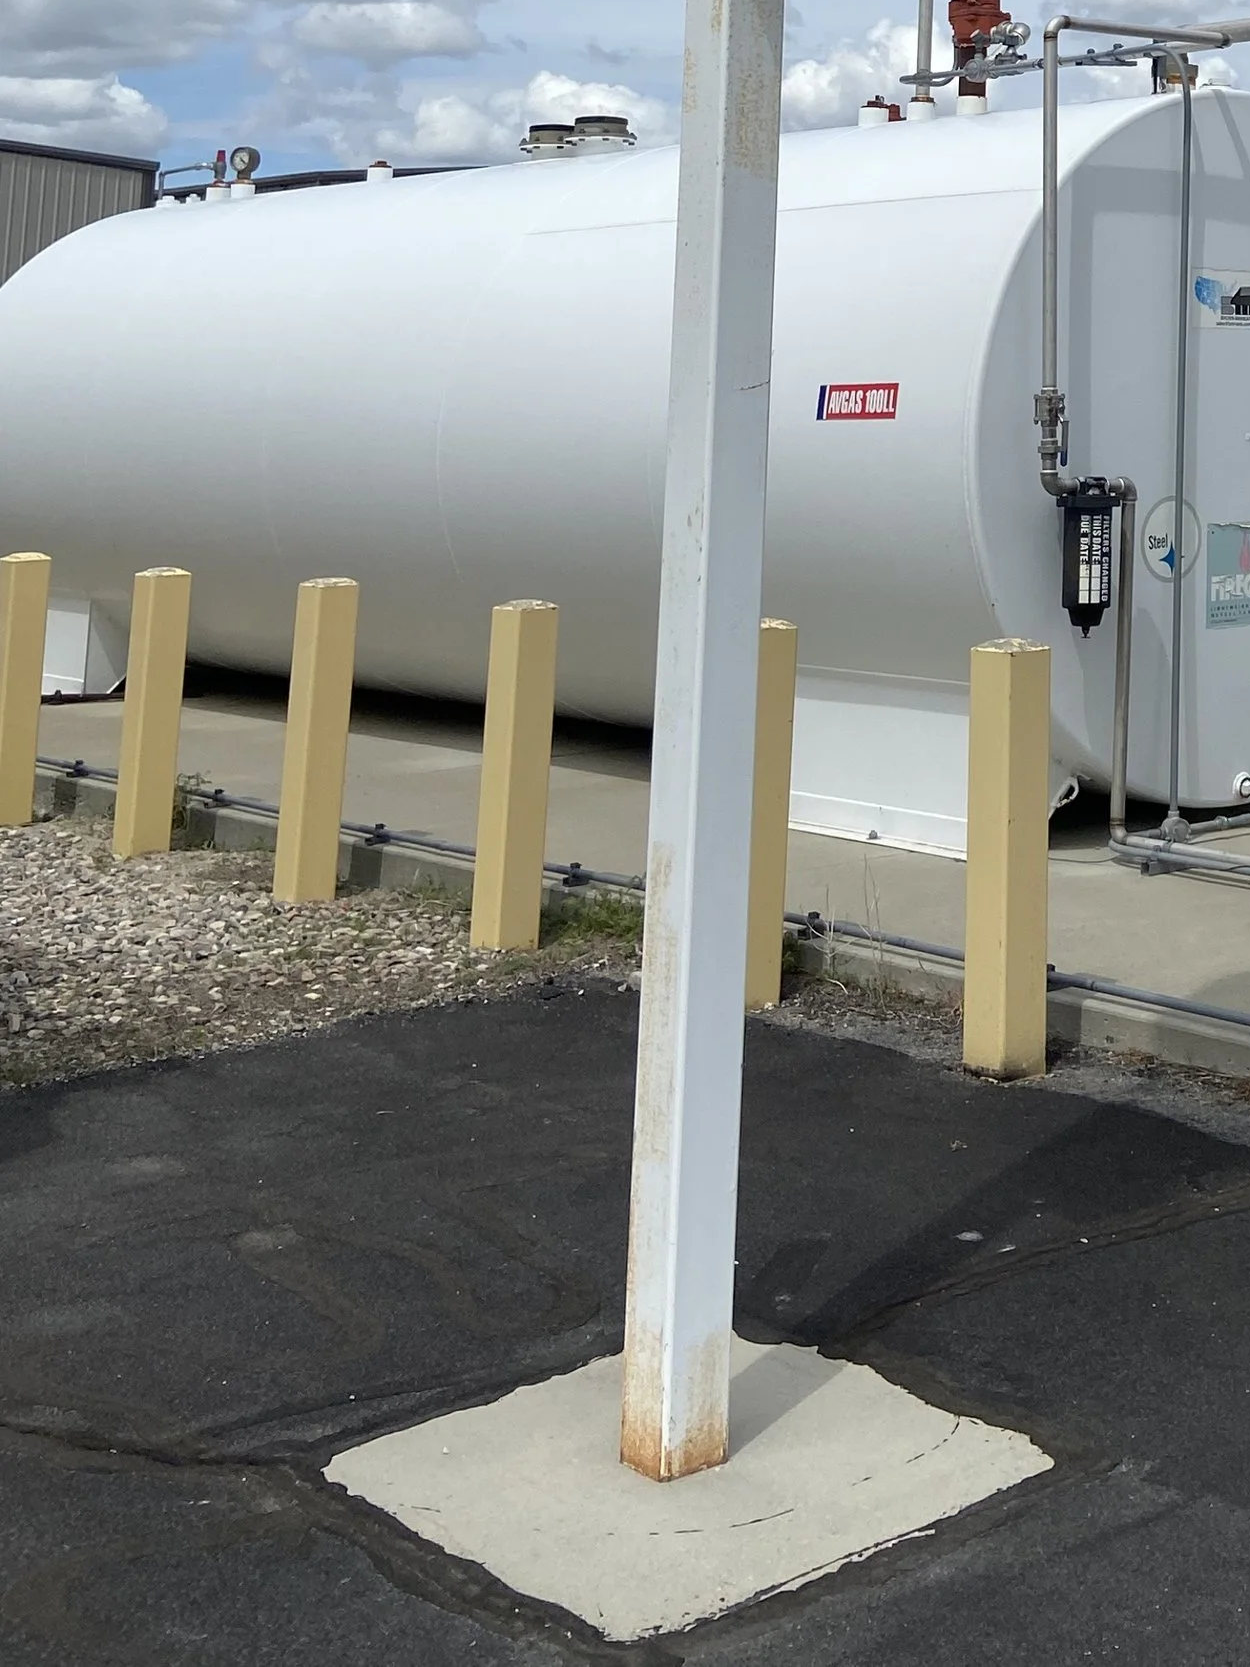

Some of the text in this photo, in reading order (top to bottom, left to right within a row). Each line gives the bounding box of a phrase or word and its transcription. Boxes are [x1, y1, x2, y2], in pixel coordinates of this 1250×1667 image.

[828, 388, 895, 415] AVGAS 100LL
[1080, 514, 1090, 534] DUE
[1092, 514, 1102, 537] THIS
[1148, 533, 1168, 550] Steel
[1101, 515, 1110, 602] FILTERS CHANGED
